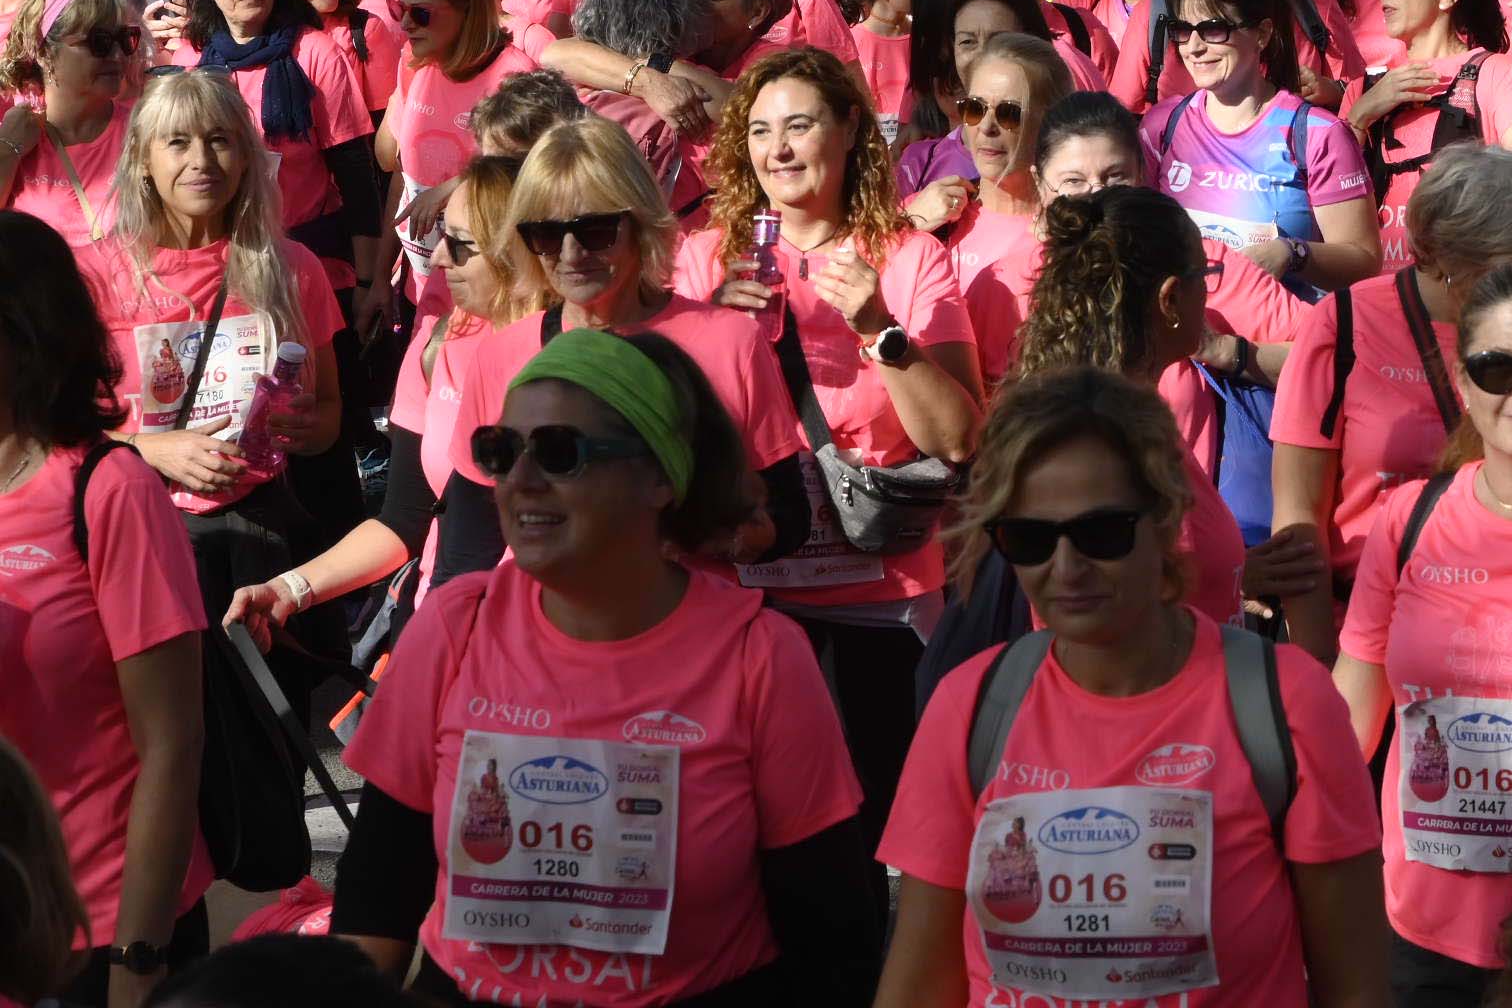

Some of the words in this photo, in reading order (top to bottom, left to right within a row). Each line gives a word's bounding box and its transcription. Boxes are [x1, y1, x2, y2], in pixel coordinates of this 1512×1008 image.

[237, 330, 258, 339] SUM
[1380, 366, 1428, 383] OYSH
[197, 390, 224, 404] 7180
[747, 567, 790, 576] OYSHO
[1421, 566, 1488, 584] OYSHO
[468, 697, 552, 729] OYSHO
[631, 723, 699, 742] ASTURIANA
[517, 774, 601, 794] ASTURIANA
[617, 772, 661, 784] SUMA
[1000, 762, 1070, 790] YSHO
[1459, 799, 1506, 815] 21447
[1149, 817, 1194, 828] SUMA
[1417, 817, 1460, 831] CARRERA
[1463, 820, 1477, 831] DE
[1481, 821, 1493, 832] LA
[519, 821, 593, 851] 016
[1048, 826, 1131, 842] ASTURIANA
[533, 859, 579, 878] 1280
[471, 883, 529, 897] CARRERA
[532, 885, 550, 896] DE
[553, 887, 569, 898] LA
[573, 889, 614, 903] MUJER
[1049, 873, 1127, 903] 016
[464, 911, 530, 929] OYSHO
[585, 919, 652, 935] Santander
[1064, 914, 1110, 932] 1281
[1004, 940, 1060, 954] CARRERA
[1065, 943, 1083, 953] DE
[1087, 943, 1103, 953] LA
[1107, 942, 1152, 953] MUJER
[1007, 961, 1067, 983] OYSHO
[1124, 966, 1197, 983] Santander
